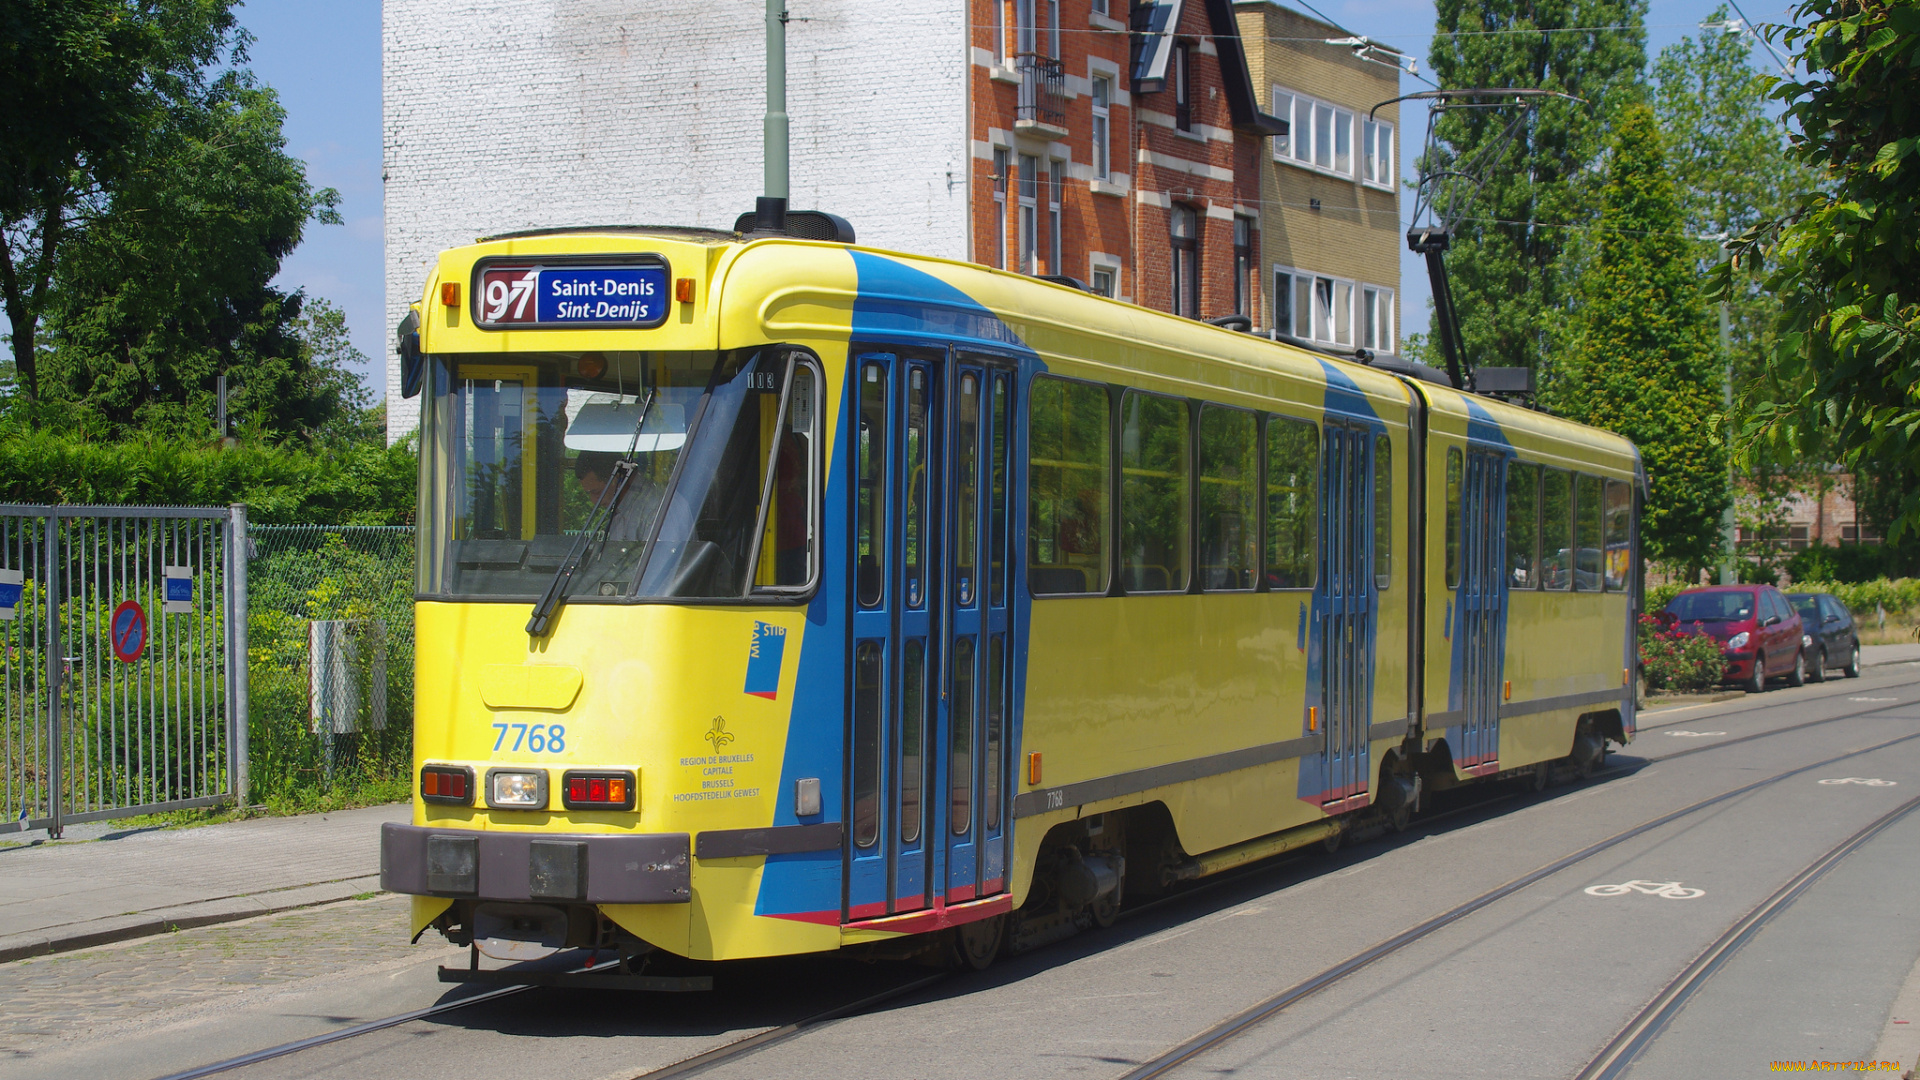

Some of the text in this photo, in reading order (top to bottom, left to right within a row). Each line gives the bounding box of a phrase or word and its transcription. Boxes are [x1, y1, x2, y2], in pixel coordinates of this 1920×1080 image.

[552, 278, 655, 297] Saint-Denis
[486, 280, 535, 320] 97
[557, 301, 649, 322] Sint-Denijs
[763, 624, 785, 637] STIB
[492, 723, 566, 753] 7768
[680, 753, 754, 766] REGION DE BRUXELLES
[703, 766, 733, 776] CAPITALE
[702, 779, 735, 789] BRUSSELS
[673, 788, 760, 802] HOOFDSTEDELIJK GEWEST
[1047, 790, 1063, 808] 7768
